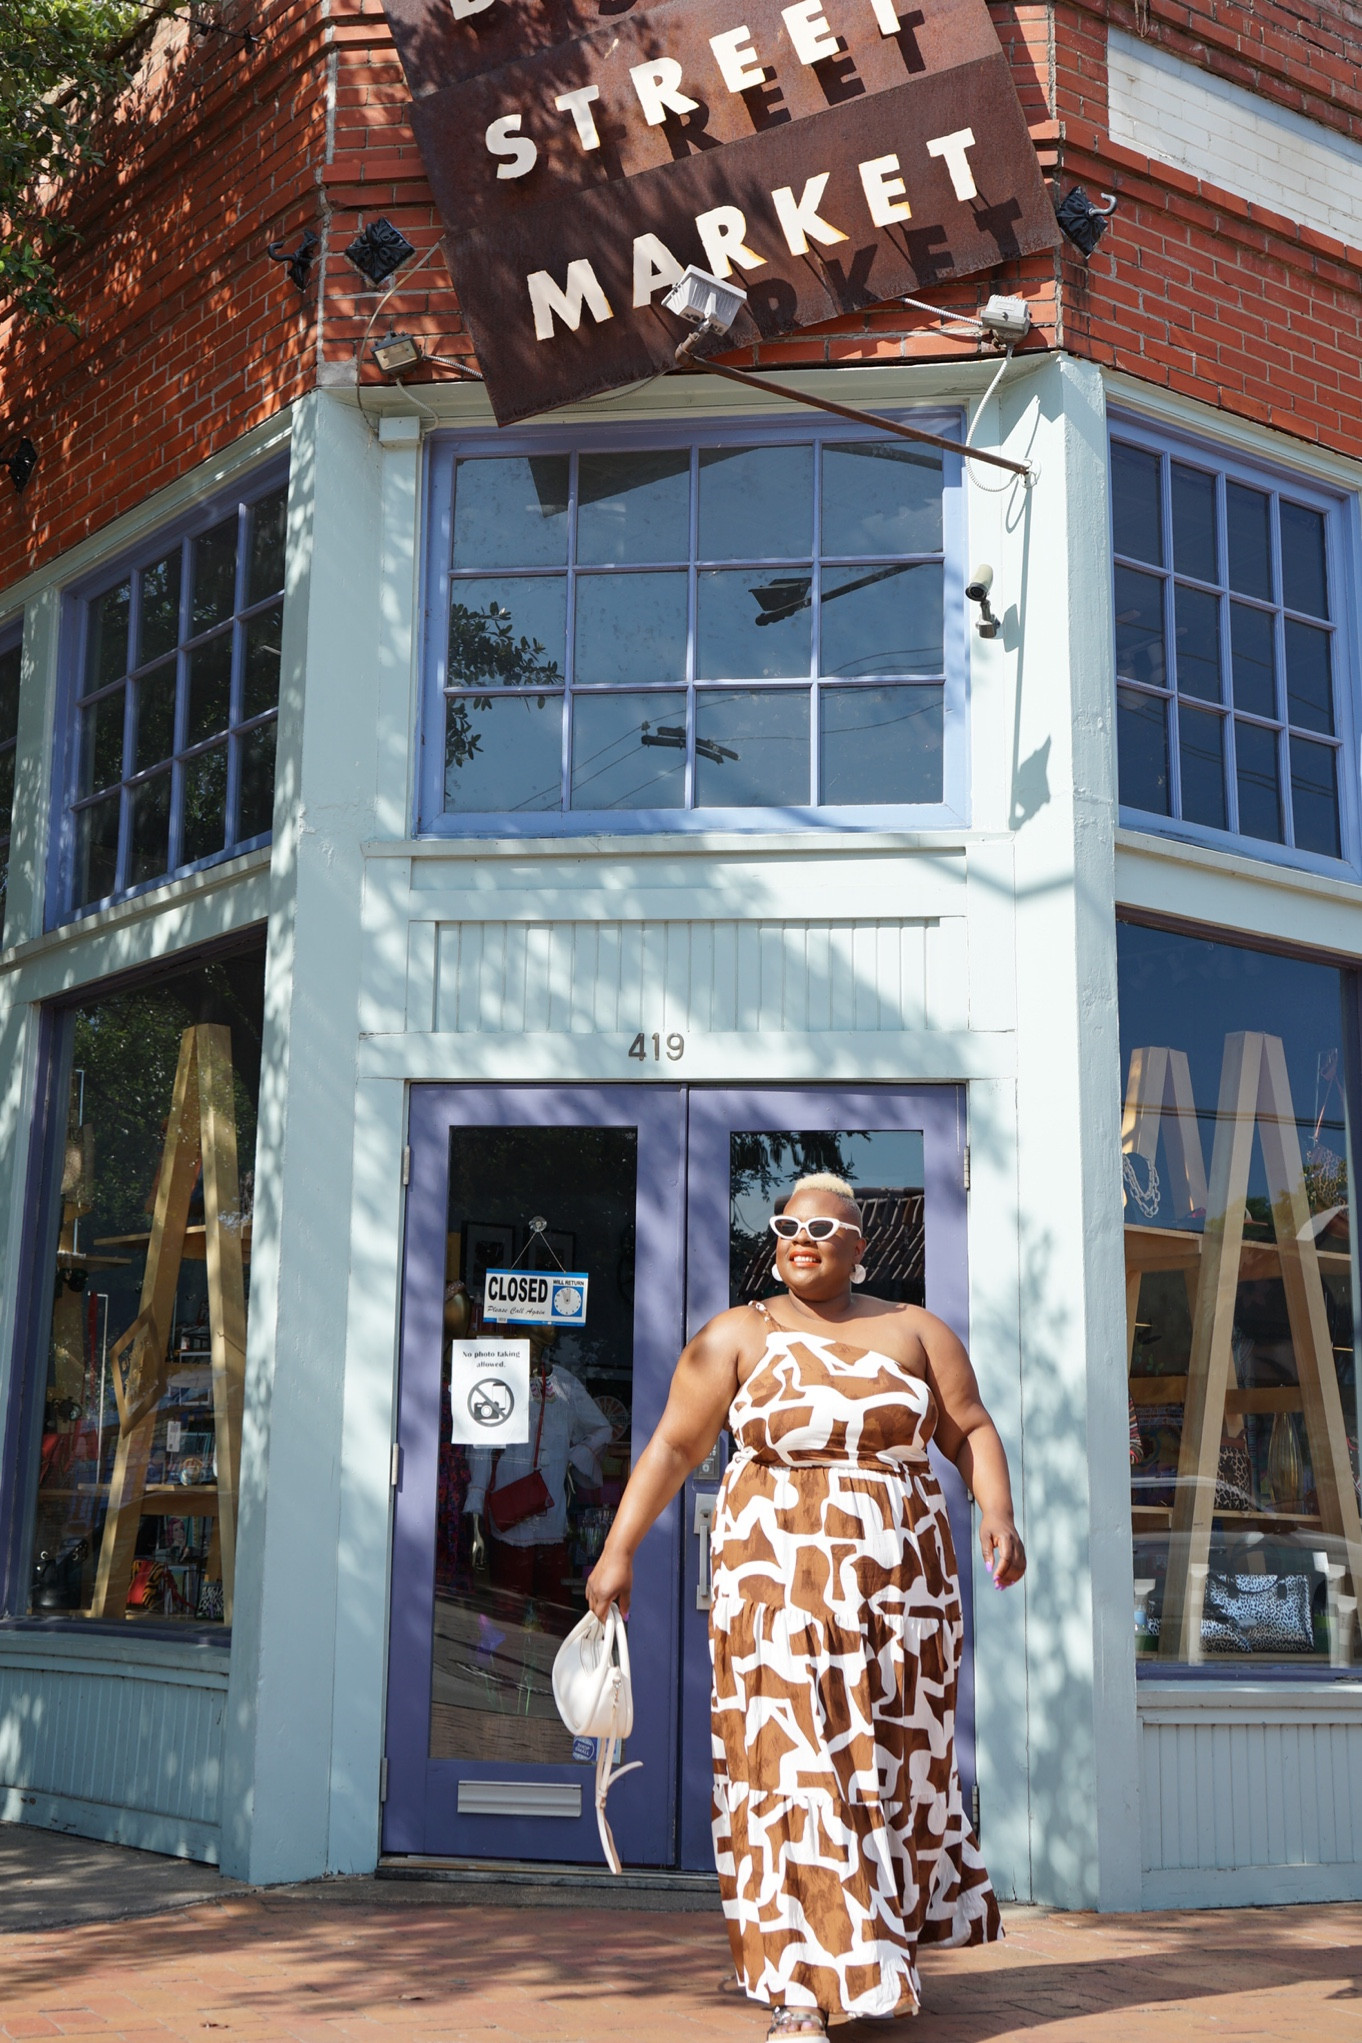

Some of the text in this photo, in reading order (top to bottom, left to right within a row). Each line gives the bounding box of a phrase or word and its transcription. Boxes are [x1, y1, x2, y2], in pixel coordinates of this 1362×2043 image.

[527, 128, 977, 340] MARKET
[628, 1032, 684, 1061] 419
[488, 1276, 548, 1303] CLOSED
[487, 1305, 545, 1316] Please Call Again
[474, 1351, 495, 1359] photo
[497, 1351, 521, 1359] taking
